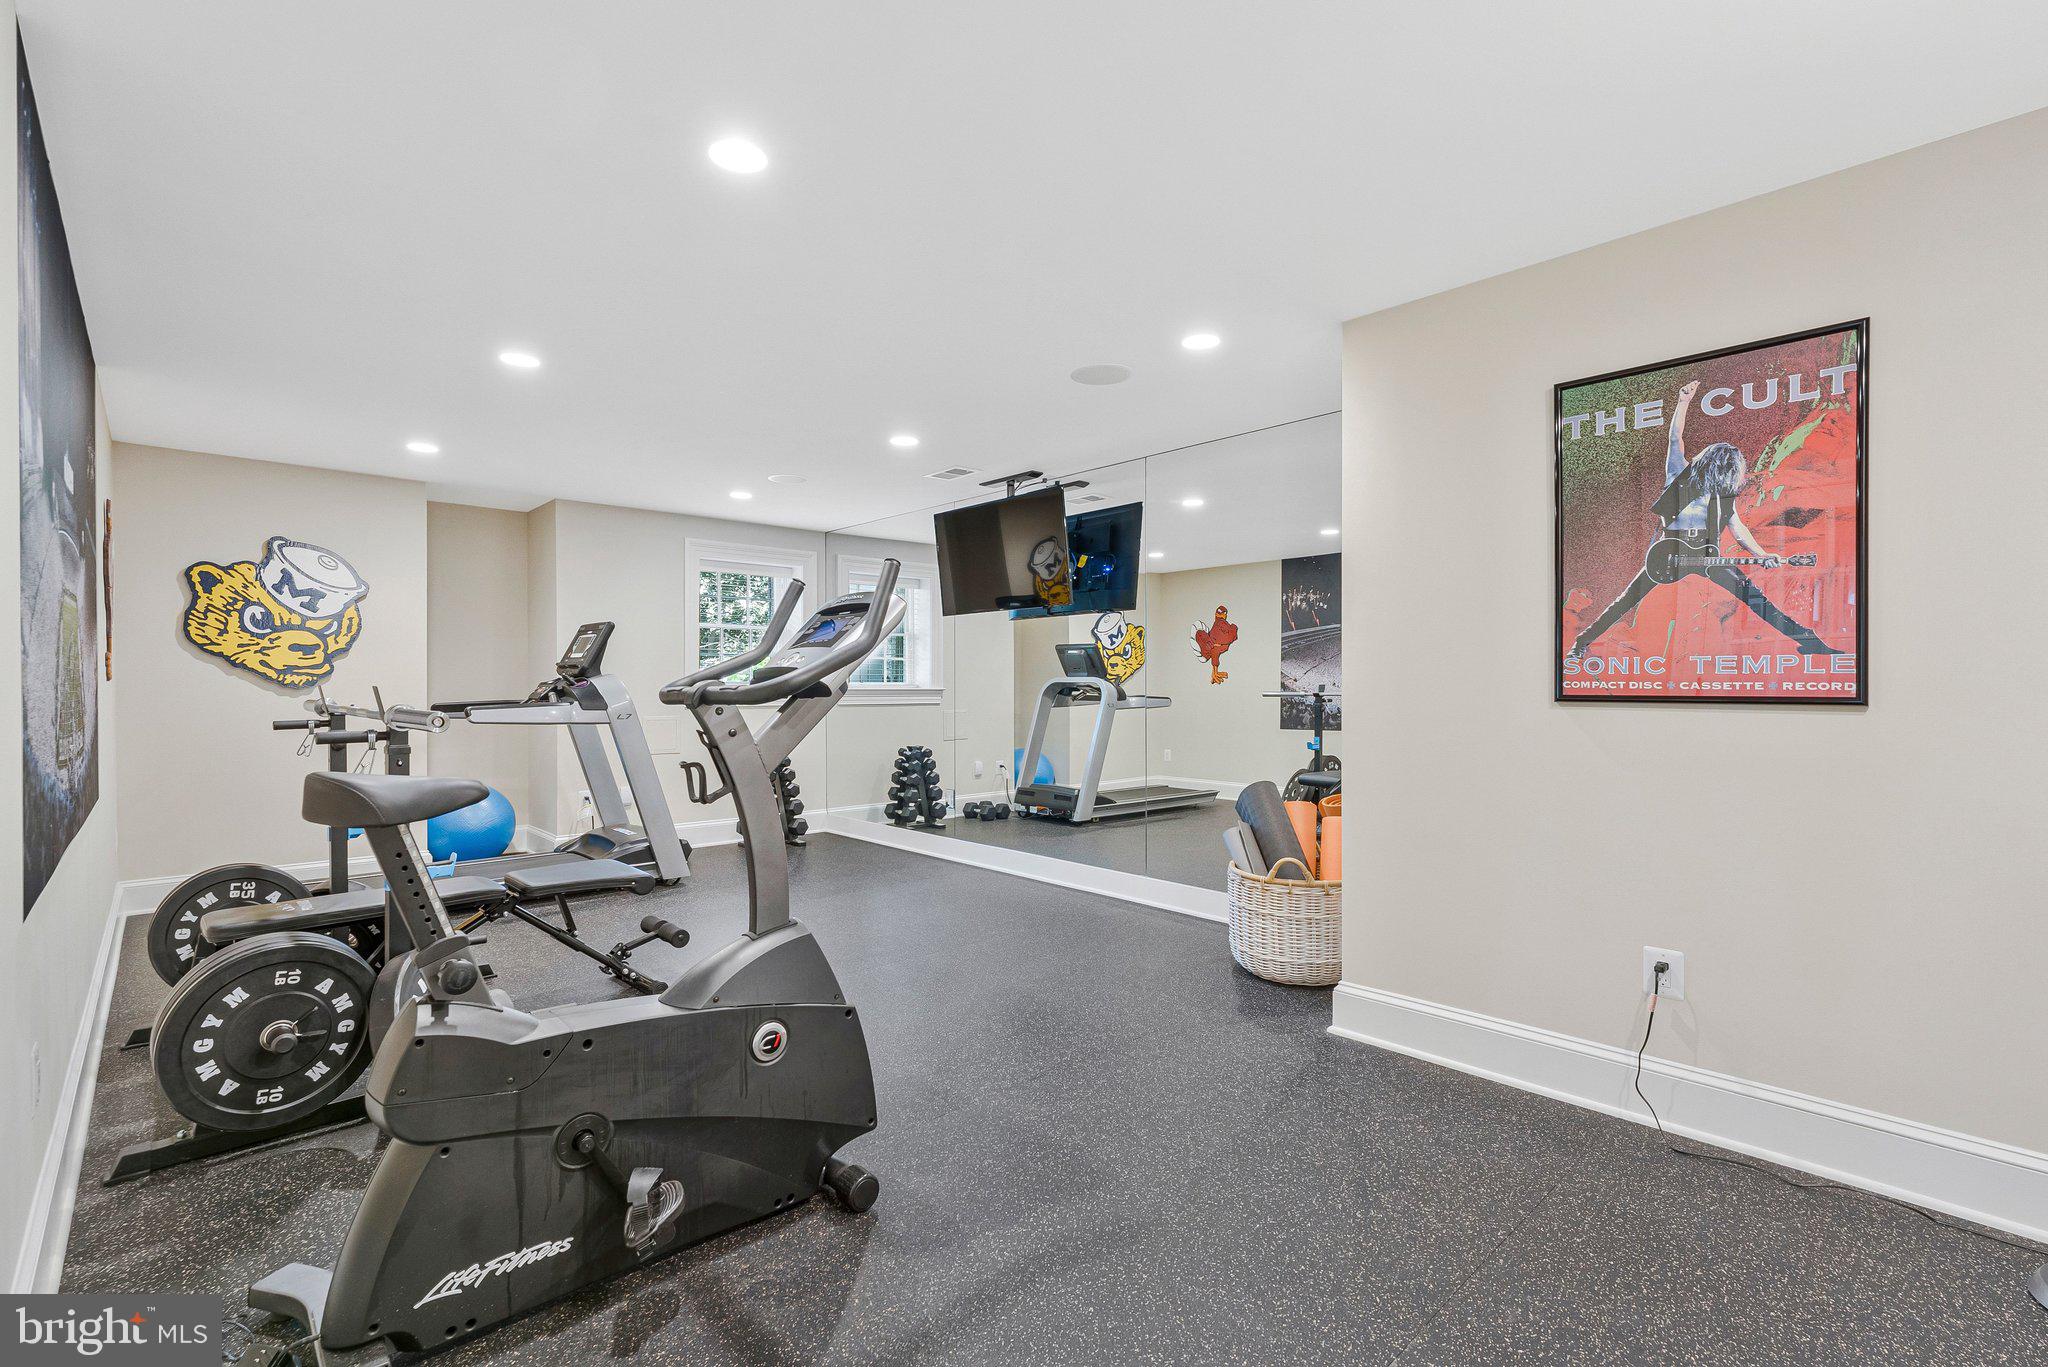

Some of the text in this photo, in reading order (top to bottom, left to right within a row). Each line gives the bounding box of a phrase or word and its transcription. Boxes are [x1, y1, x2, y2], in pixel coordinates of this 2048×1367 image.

[1563, 363, 1857, 440] THE CULT
[271, 567, 327, 614] M
[1563, 654, 1857, 675] SONIC TEMPLE
[1563, 681, 1857, 691] COMPACT DISC CASSETTE RECORD
[229, 882, 242, 899] LB
[241, 881, 256, 899] 35
[174, 891, 219, 962] MGYM
[274, 970, 287, 986] LB
[286, 968, 302, 986] 10
[304, 977, 355, 1082] AMGYM
[193, 986, 250, 1097] AMGYM
[255, 1088, 268, 1105] LB
[268, 1085, 284, 1102] 10
